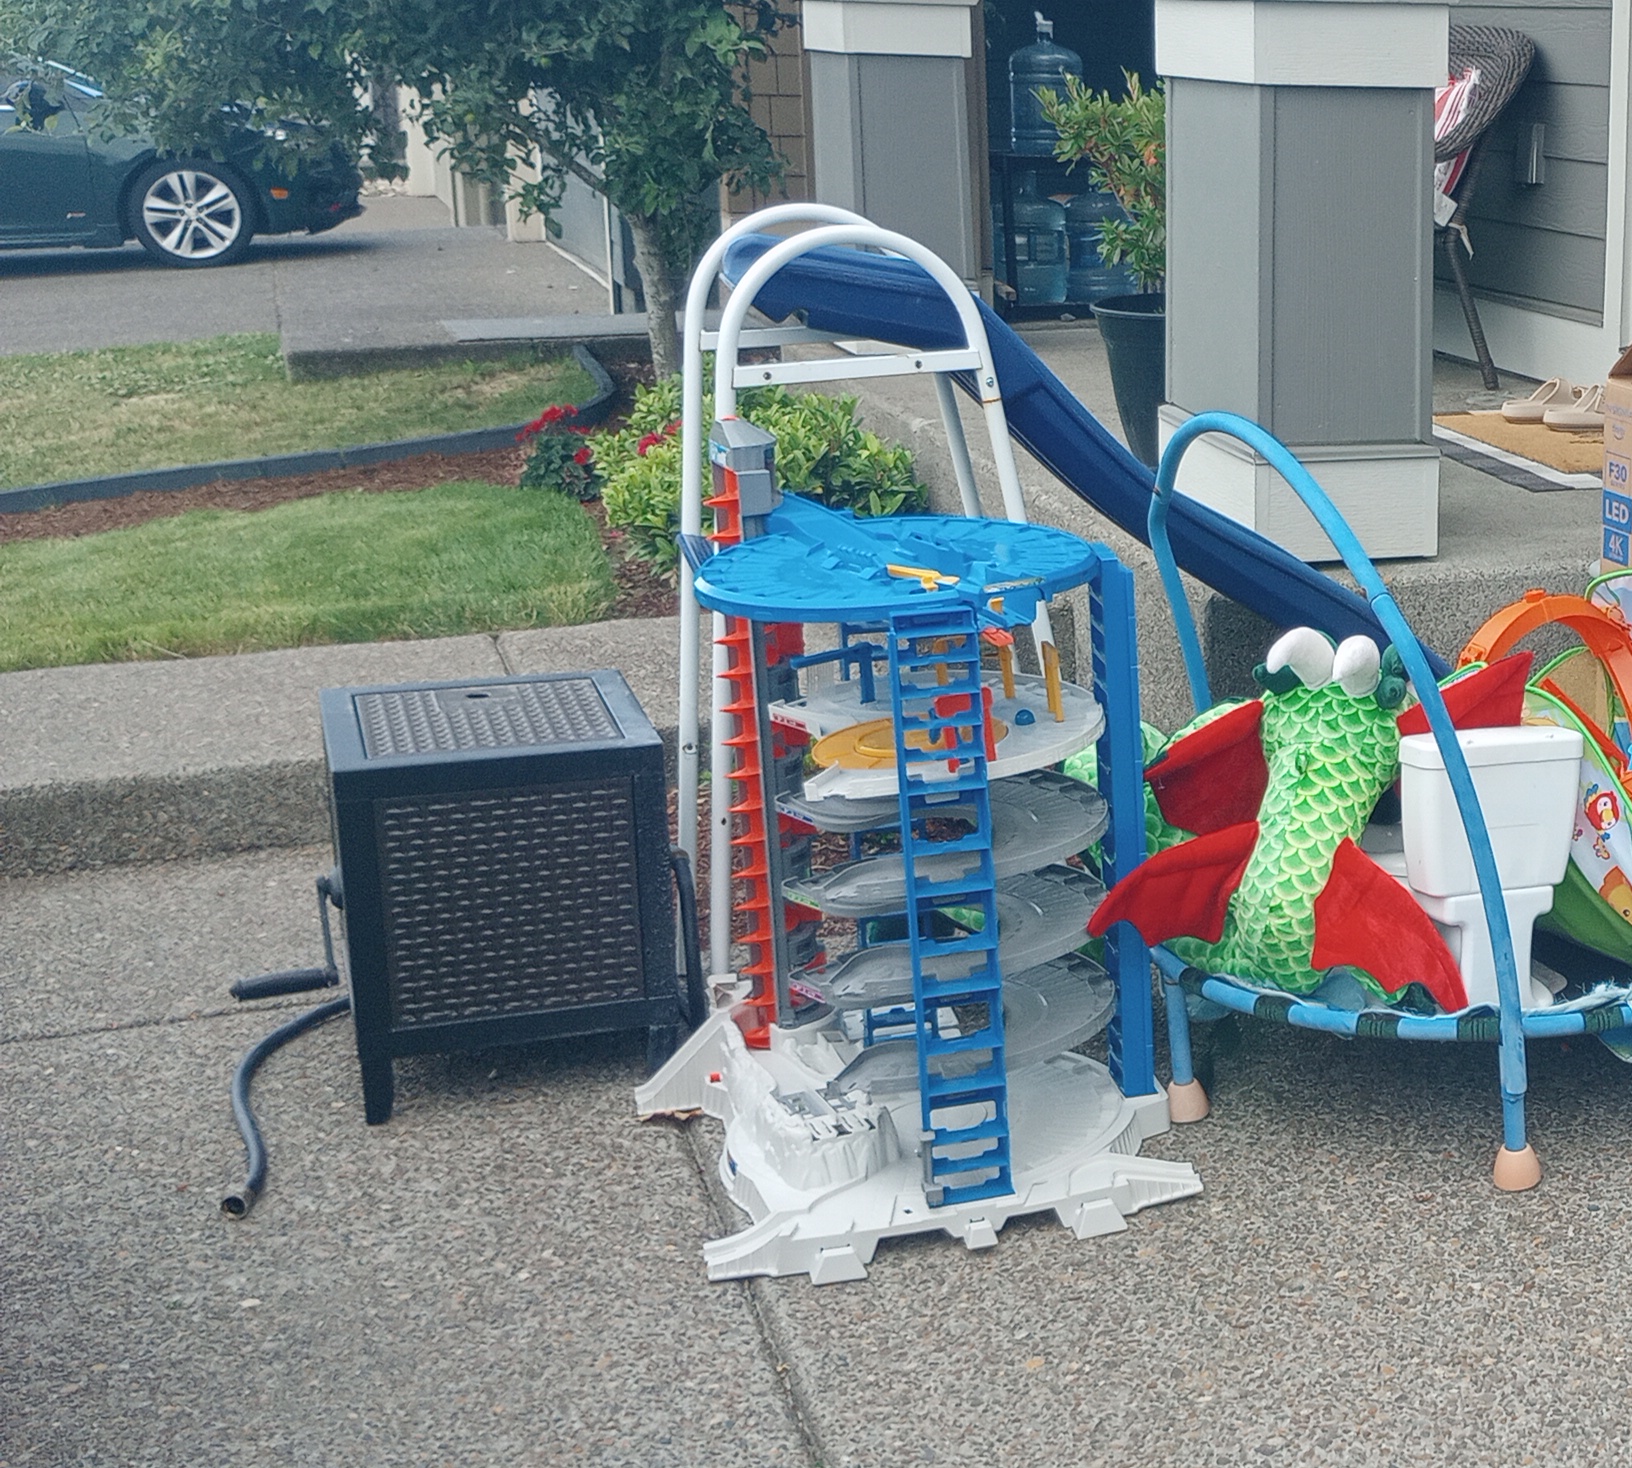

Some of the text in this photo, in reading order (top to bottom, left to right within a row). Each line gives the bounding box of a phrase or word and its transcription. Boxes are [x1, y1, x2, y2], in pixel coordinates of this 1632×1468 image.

[1608, 461, 1628, 483] F30
[1605, 499, 1629, 525] LED
[1609, 533, 1624, 555] 4K
